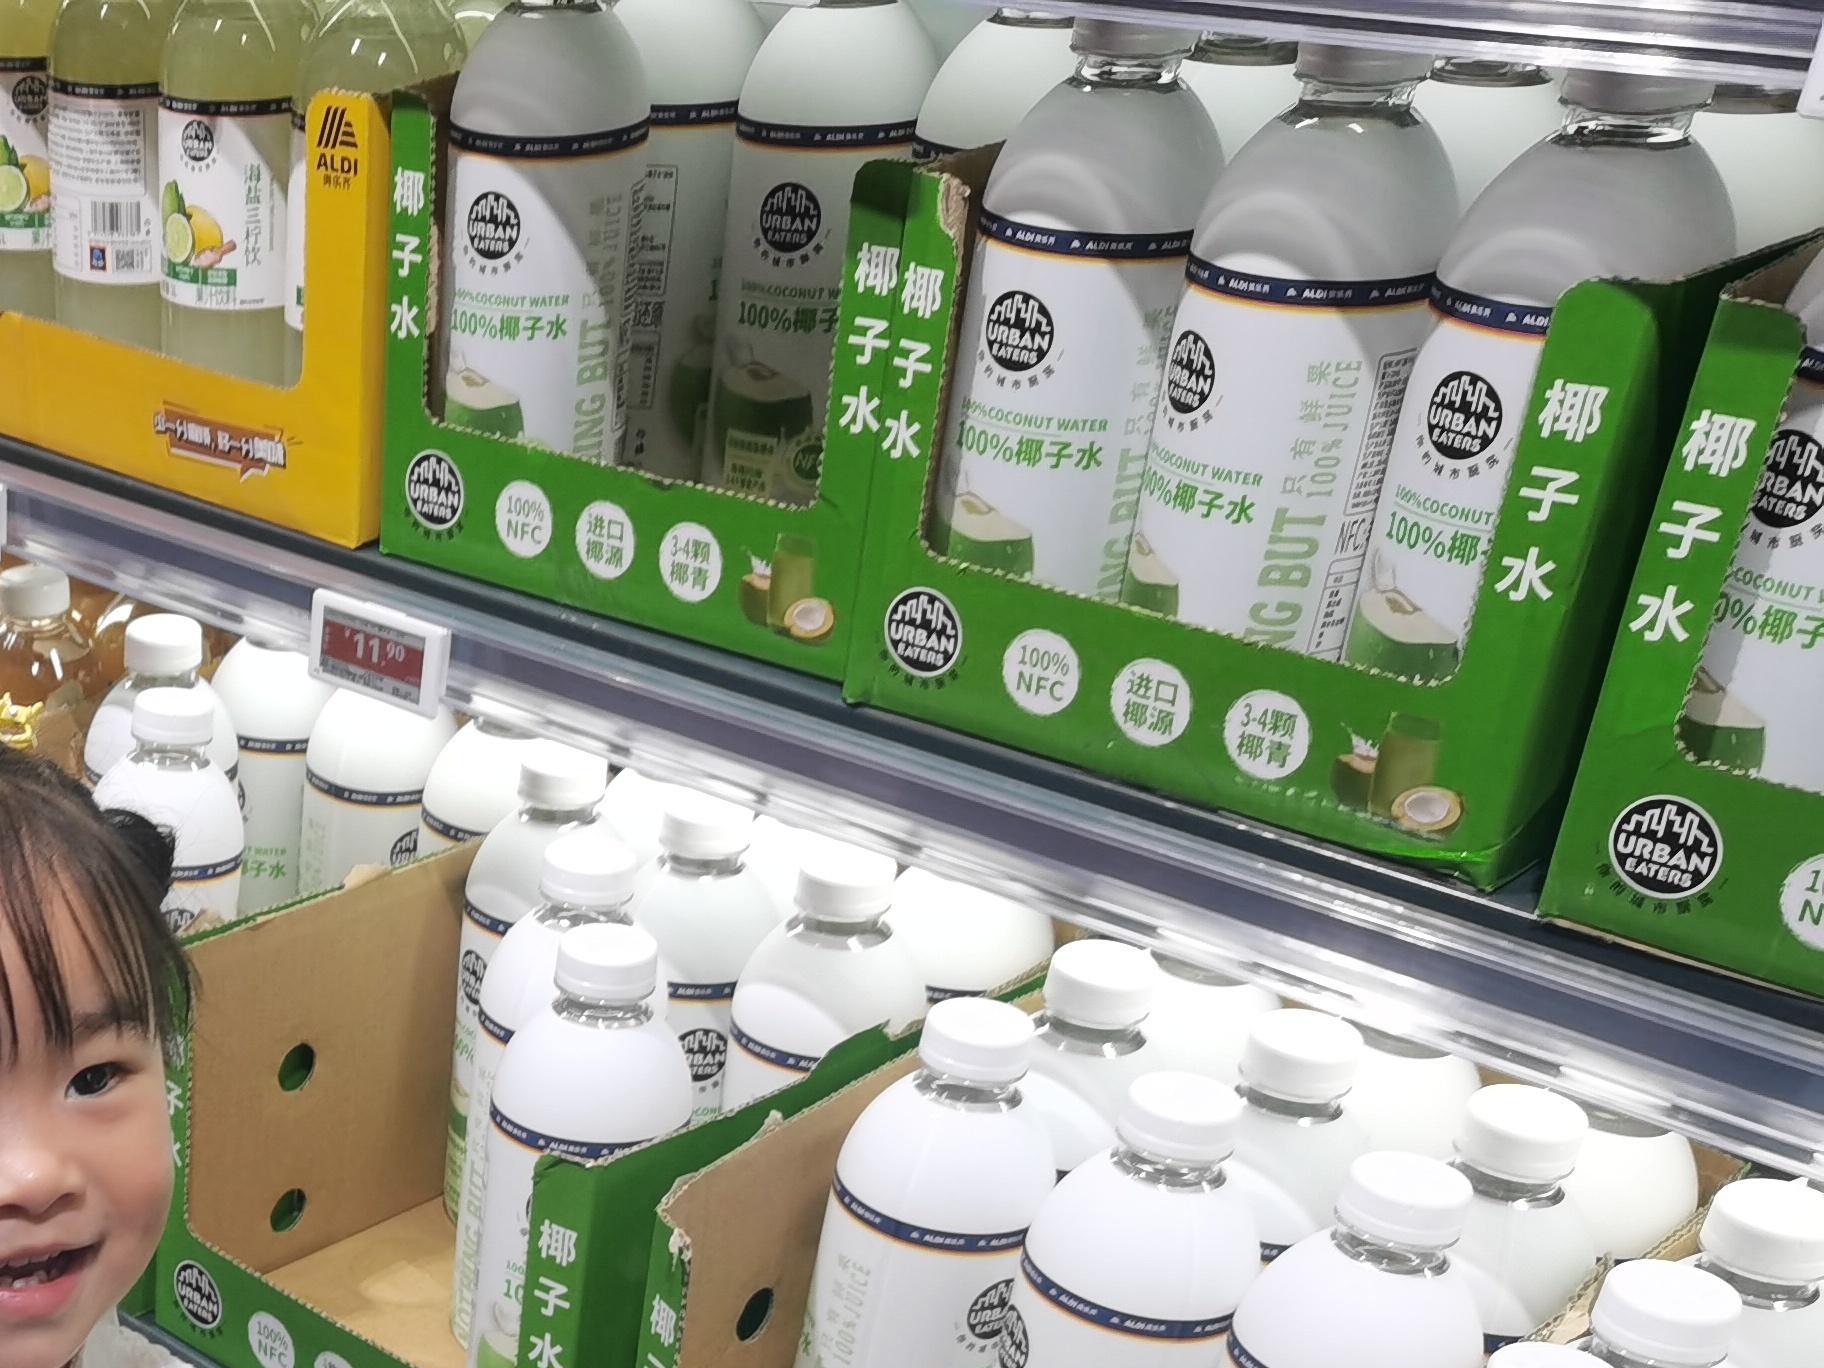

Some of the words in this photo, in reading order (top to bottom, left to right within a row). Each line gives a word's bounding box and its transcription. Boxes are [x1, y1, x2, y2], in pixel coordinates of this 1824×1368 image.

[317, 152, 359, 177] ALDI
[469, 218, 519, 242] URBAN
[762, 212, 818, 232] URBAN
[389, 166, 425, 341] 椰子水
[450, 308, 568, 342] 100%椰子水
[838, 241, 902, 436] 椰子水
[988, 324, 1050, 353] URBAN
[880, 261, 945, 460] 椰子水
[991, 343, 1038, 365] EATERS
[1322, 359, 1363, 432] JUICE
[1056, 415, 1108, 433] WATER
[1429, 405, 1497, 439] URBAN
[956, 422, 1103, 472] 100%椰子水
[1432, 426, 1483, 453] EATERS
[410, 481, 460, 507] URBAN
[1211, 466, 1263, 489] WATER
[1494, 378, 1610, 602] 椰子水
[415, 499, 453, 520] EATERS
[506, 493, 546, 519] 100%
[506, 520, 543, 545] NFC
[585, 510, 625, 544] 进口
[1628, 409, 1758, 643] 椰子水
[584, 540, 624, 570] 椰源
[1256, 506, 1328, 589] BUT
[668, 560, 710, 592] 椰青
[889, 620, 956, 654] URBAN
[897, 643, 945, 669] EATERS
[1018, 644, 1070, 677] 100%
[1015, 671, 1066, 703] NFC
[1126, 669, 1179, 708] 进口
[1121, 699, 1175, 737] 椰源
[1240, 701, 1297, 739] 3-4颗
[1235, 732, 1292, 769] 椰青
[1616, 832, 1713, 877] URBAN
[1624, 856, 1694, 889] EATERS
[177, 1283, 219, 1317] URBAN
[256, 1320, 289, 1350] 100%
[256, 1337, 289, 1368] NFC
